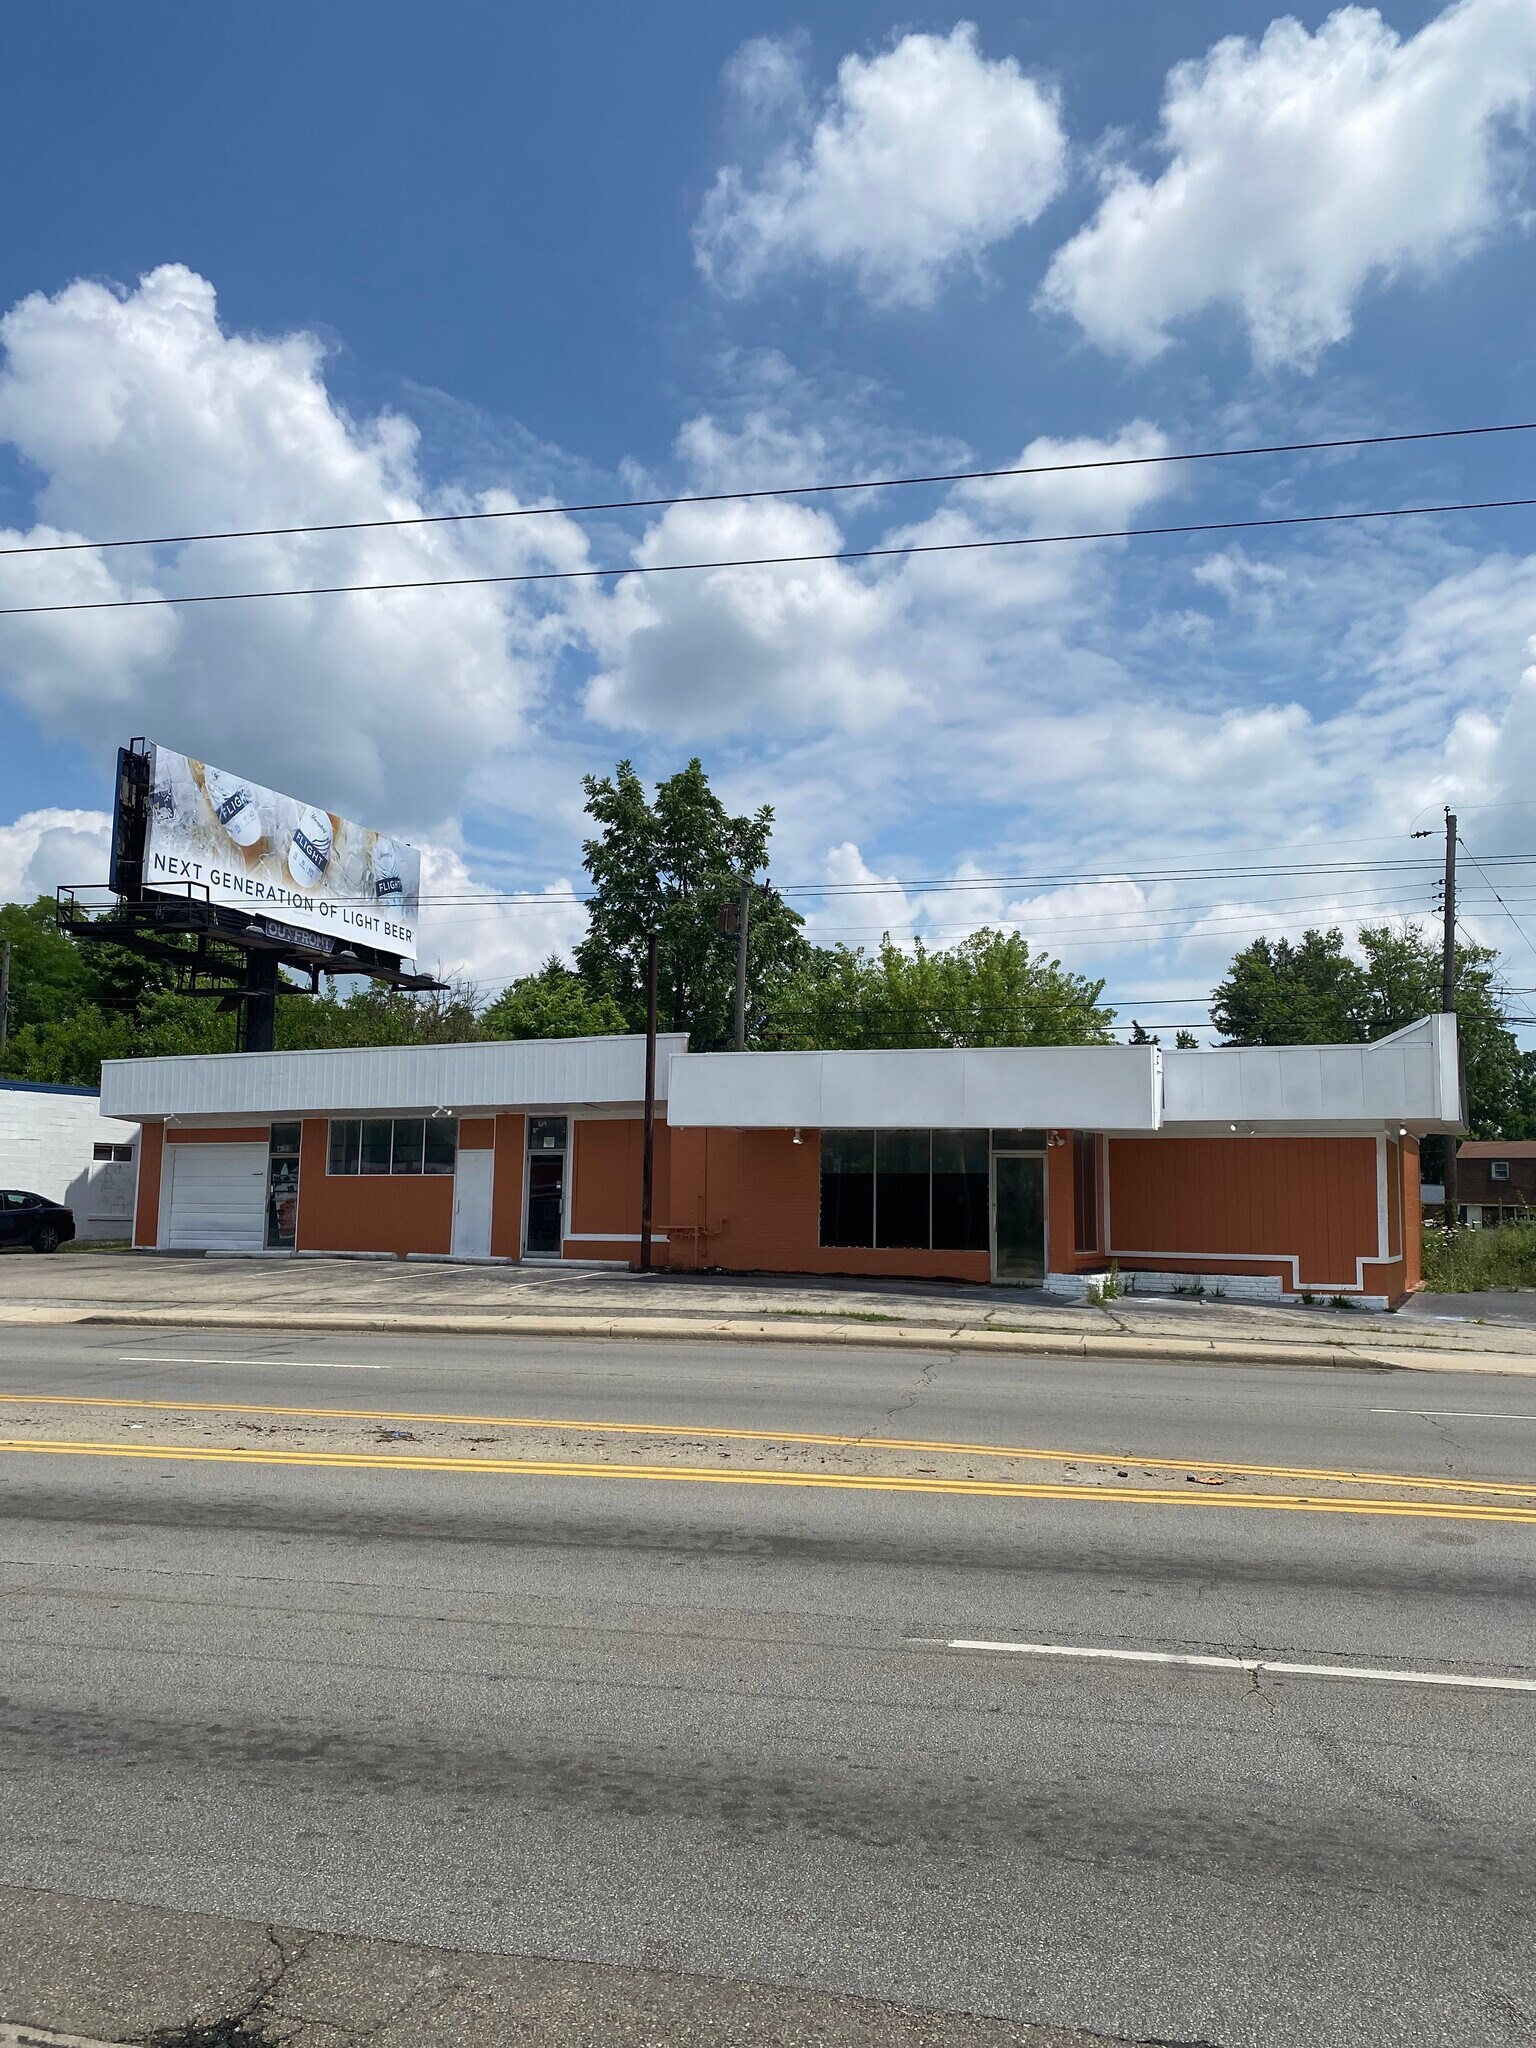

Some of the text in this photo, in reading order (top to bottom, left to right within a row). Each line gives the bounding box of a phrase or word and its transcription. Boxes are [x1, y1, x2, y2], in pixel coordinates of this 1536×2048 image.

[295, 832, 324, 866] FLIGHT
[154, 852, 413, 943] NEXT GENERATION OF LIGHT BEER
